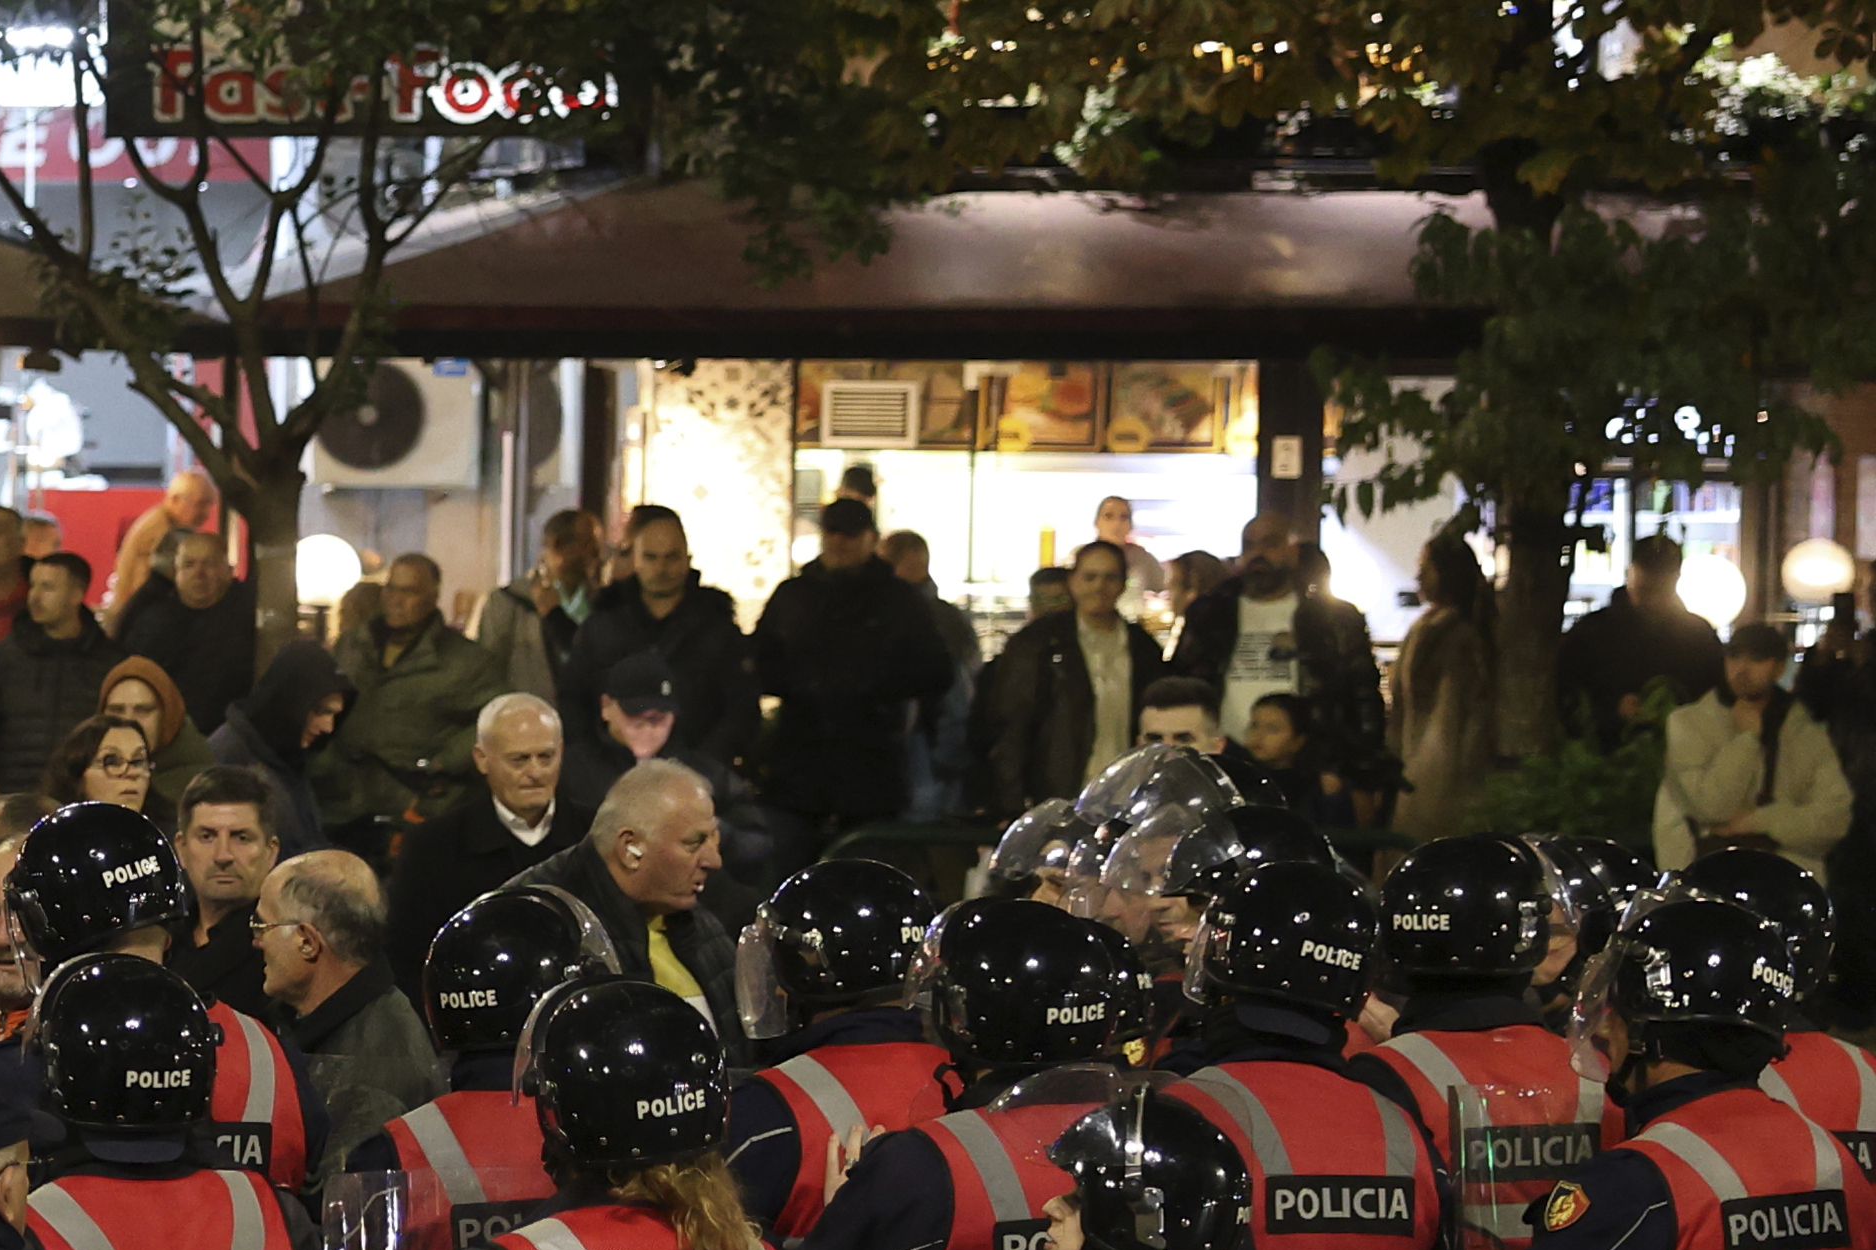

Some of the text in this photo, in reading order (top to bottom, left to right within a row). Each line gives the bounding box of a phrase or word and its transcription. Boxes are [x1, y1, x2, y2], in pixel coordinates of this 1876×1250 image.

[102, 855, 161, 888] POLICE
[1393, 914, 1450, 931] POLICE
[1300, 940, 1363, 971] POLICE
[440, 989, 499, 1009] POLICE
[1046, 1002, 1105, 1025] POLICE
[125, 1068, 191, 1088] POLICE
[636, 1089, 706, 1119] POLICE
[1469, 1134, 1593, 1169] POLICIA
[1275, 1187, 1409, 1220] POLICIA
[1728, 1201, 1843, 1246] POLICIA
